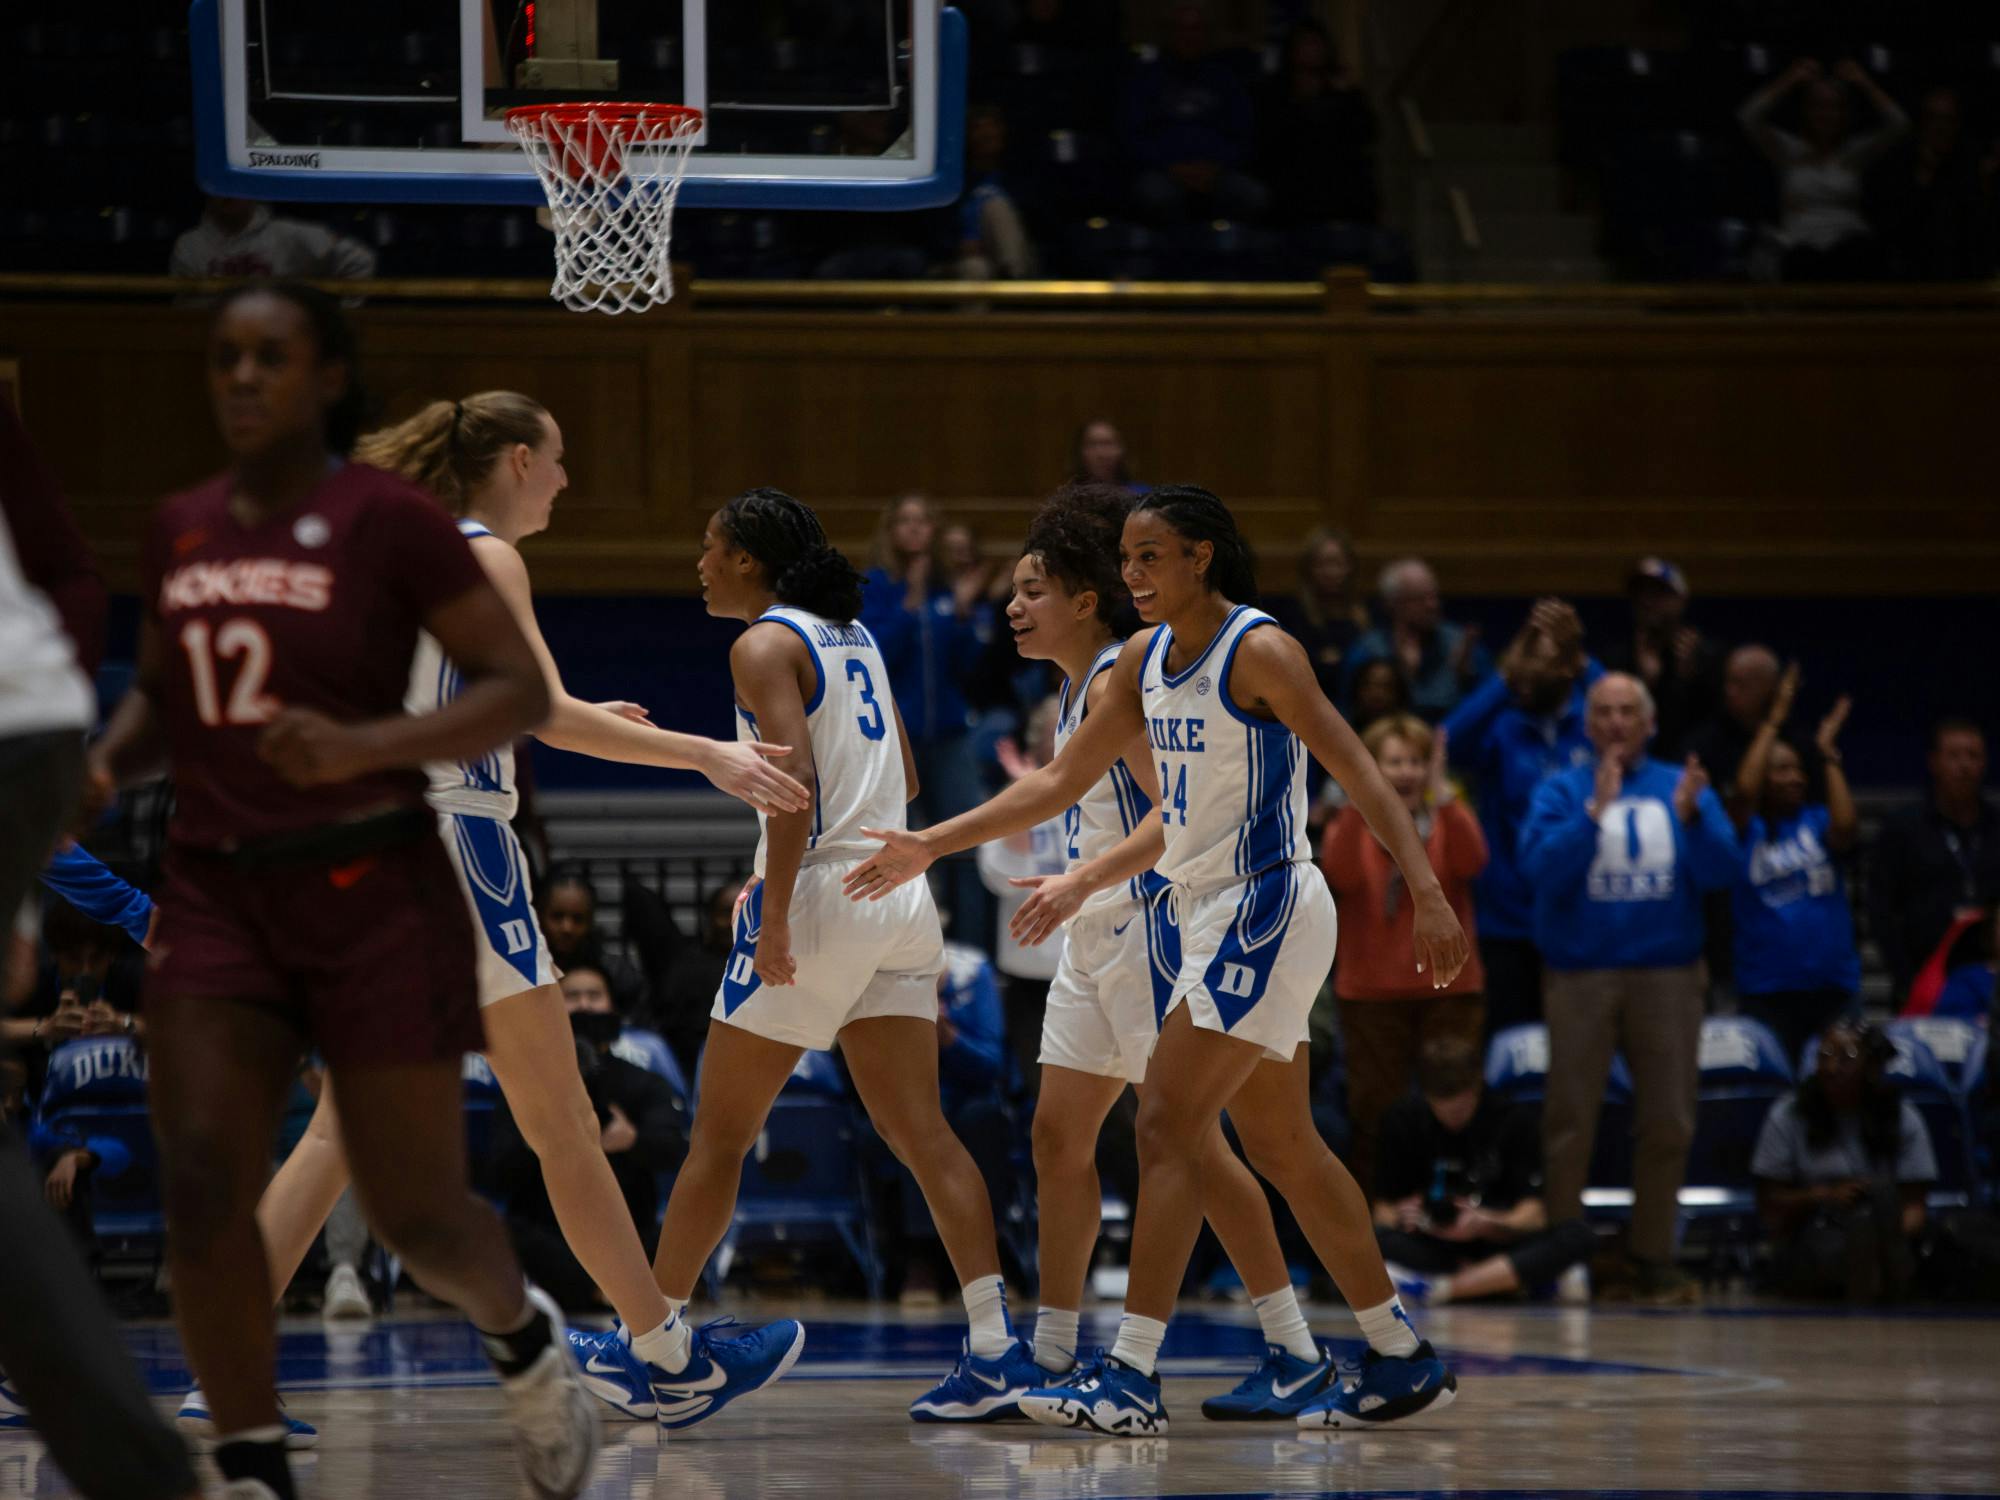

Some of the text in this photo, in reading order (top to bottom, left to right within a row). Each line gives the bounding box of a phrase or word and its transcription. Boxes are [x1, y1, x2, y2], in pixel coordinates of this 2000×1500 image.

[248, 151, 320, 169] SPALDING
[179, 617, 284, 728] 12
[845, 658, 886, 741] 3
[498, 918, 532, 956] D
[728, 951, 755, 986] D
[1216, 961, 1256, 999] D
